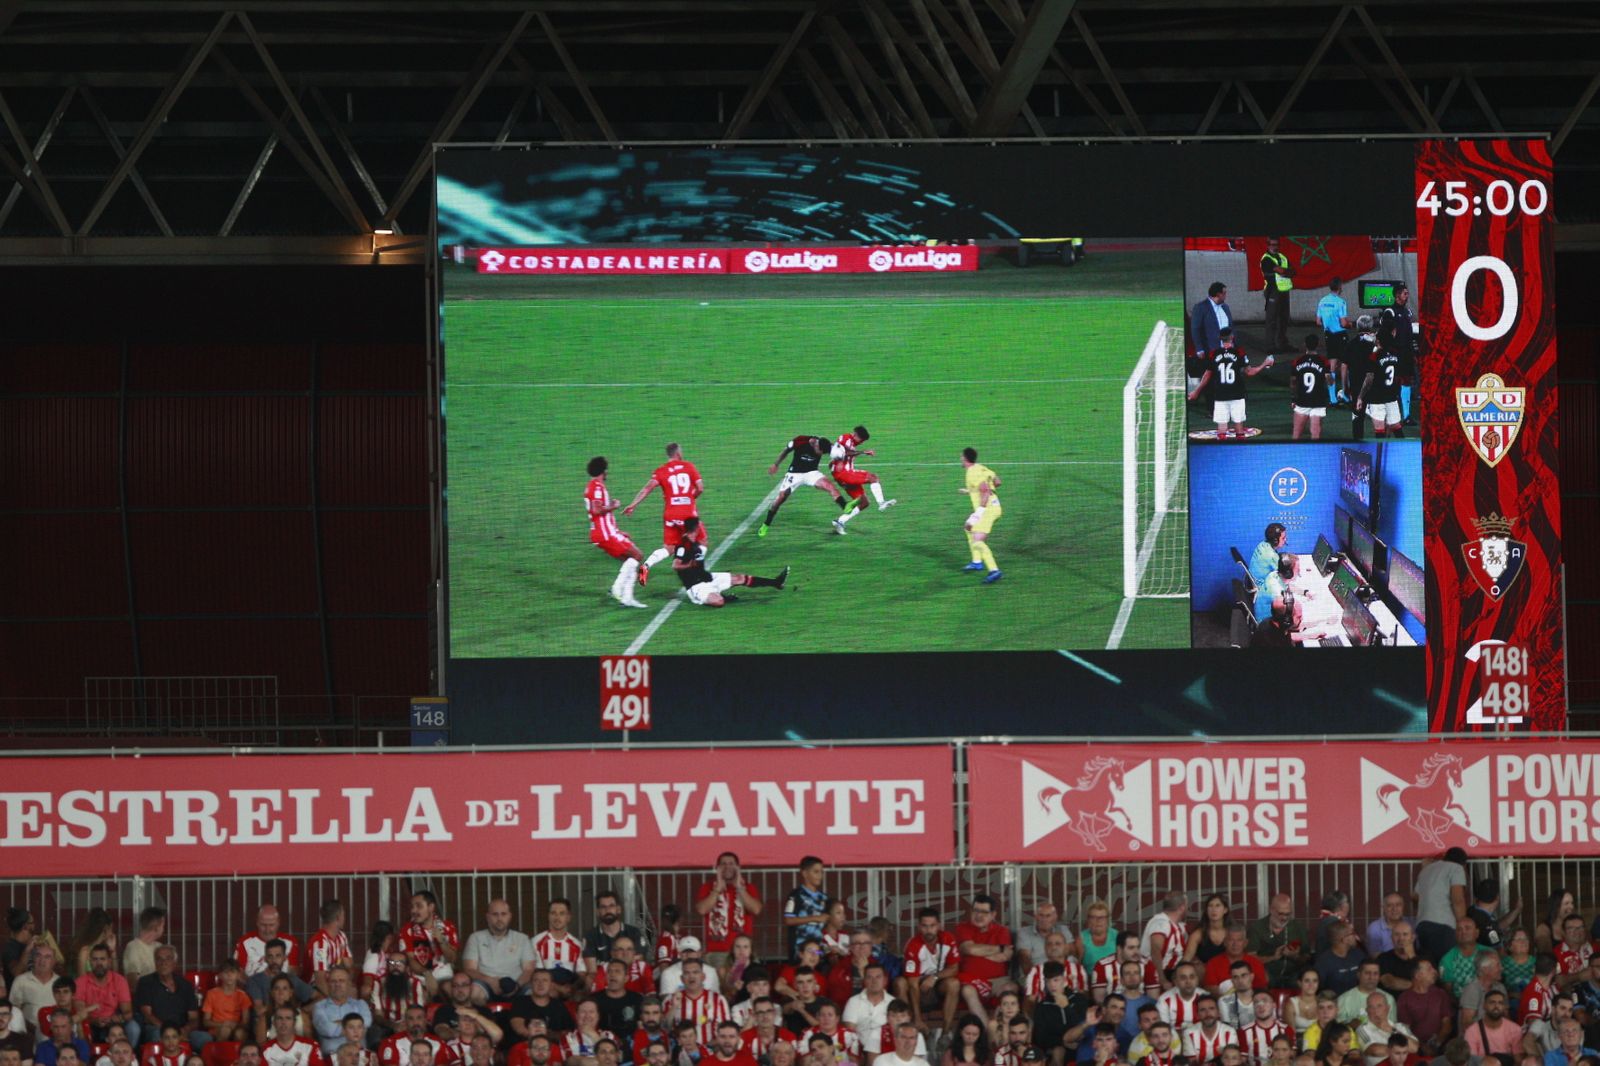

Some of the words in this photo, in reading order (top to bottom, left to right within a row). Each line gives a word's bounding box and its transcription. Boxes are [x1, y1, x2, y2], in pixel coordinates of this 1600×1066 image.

[1416, 179, 1548, 217] 45:00
[770, 251, 838, 271] LaLiga
[894, 250, 962, 270] LaLiga
[1451, 255, 1519, 341] 0
[1218, 362, 1236, 384] 16
[1303, 372, 1316, 393] 9
[1385, 365, 1395, 386] 3
[1464, 394, 1478, 405] U
[1502, 394, 1517, 405] D
[1465, 412, 1517, 422] ALMERIA
[667, 472, 692, 495] 19
[602, 659, 641, 689] 149
[1481, 646, 1521, 677] 148
[602, 694, 642, 728] 49
[1482, 682, 1522, 715] 48
[413, 711, 445, 727] 148
[1158, 757, 1308, 803] POWER
[0, 787, 453, 848] ESTRELLA
[465, 799, 520, 827] DE
[530, 780, 926, 840] LEVANTE
[1159, 802, 1309, 849] HORSE
